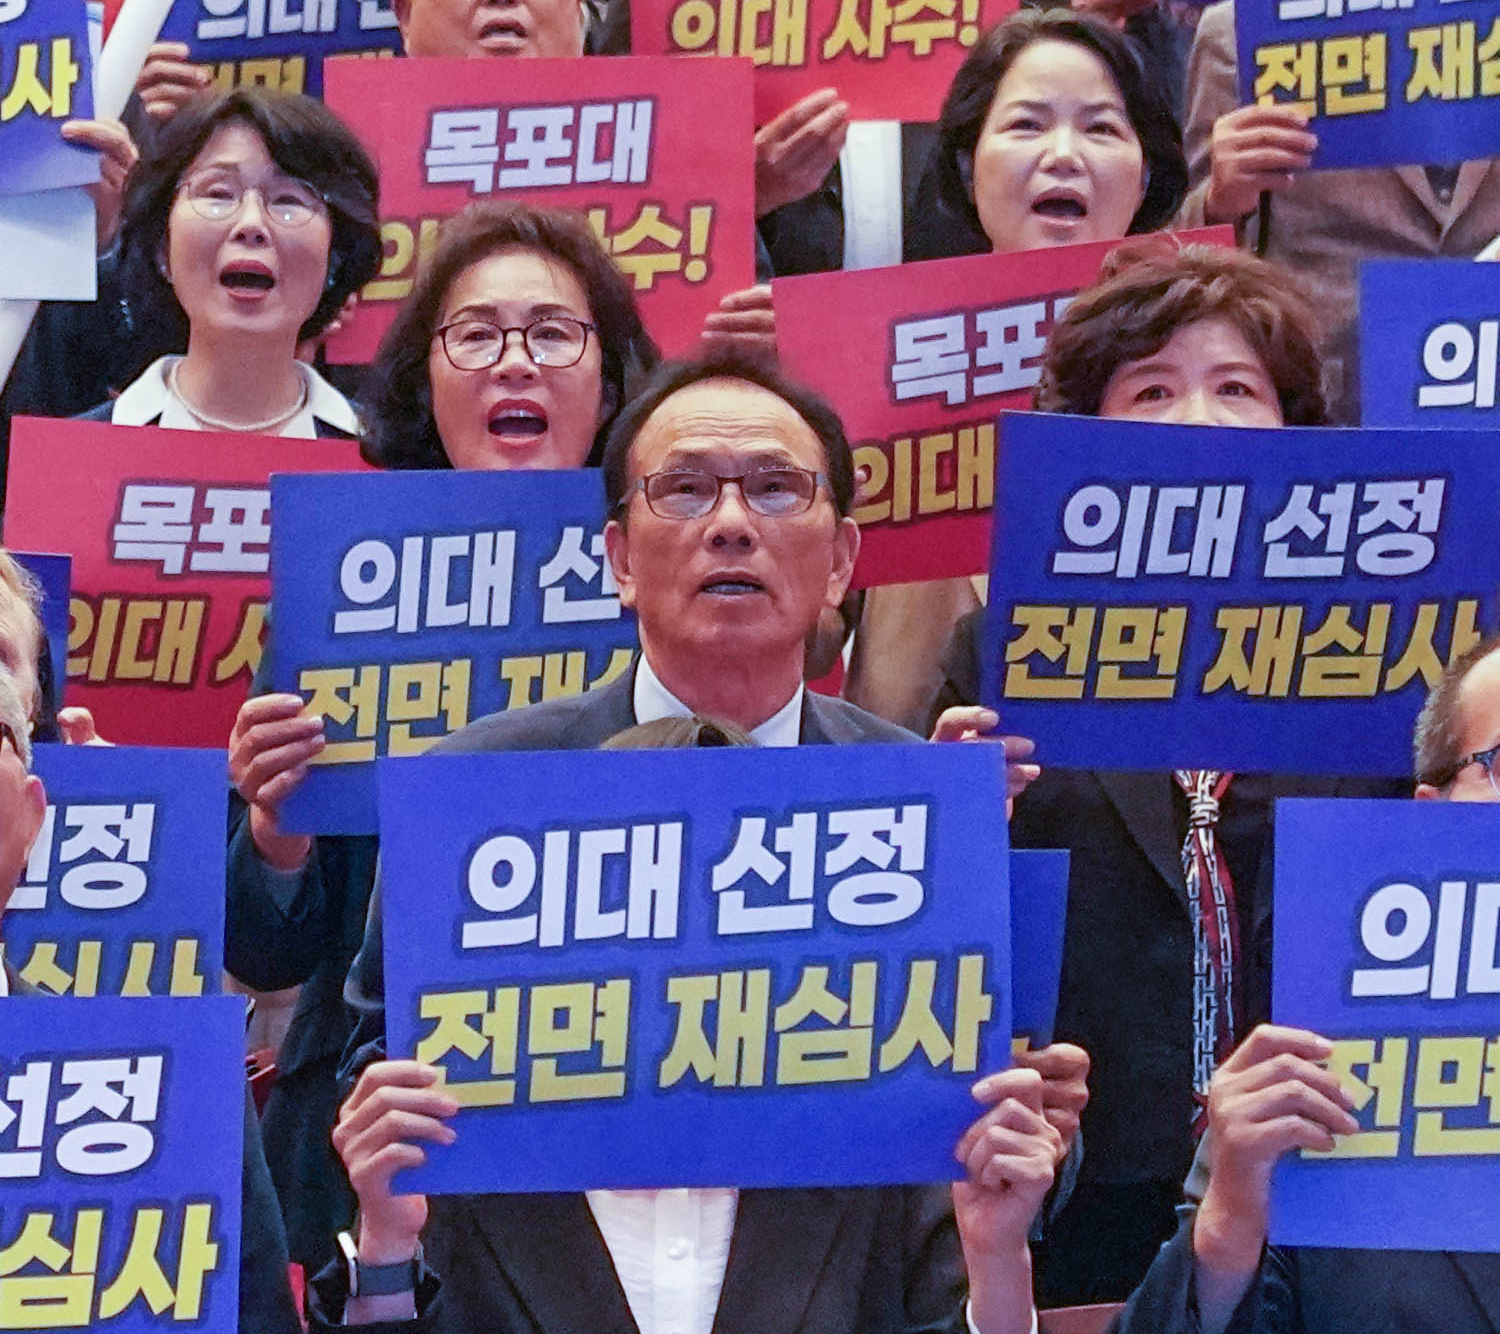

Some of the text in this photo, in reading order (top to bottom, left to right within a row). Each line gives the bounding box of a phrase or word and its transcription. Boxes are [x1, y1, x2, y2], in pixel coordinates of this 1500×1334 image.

[1243, 34, 1385, 121] 전면
[425, 101, 652, 192] 목포대
[1053, 479, 1444, 577] 의대 선정
[335, 531, 515, 633] 의대
[1005, 601, 1479, 697] 전면 재심사
[463, 805, 927, 948] 의대 선정
[418, 960, 988, 1103] 전면 재심사
